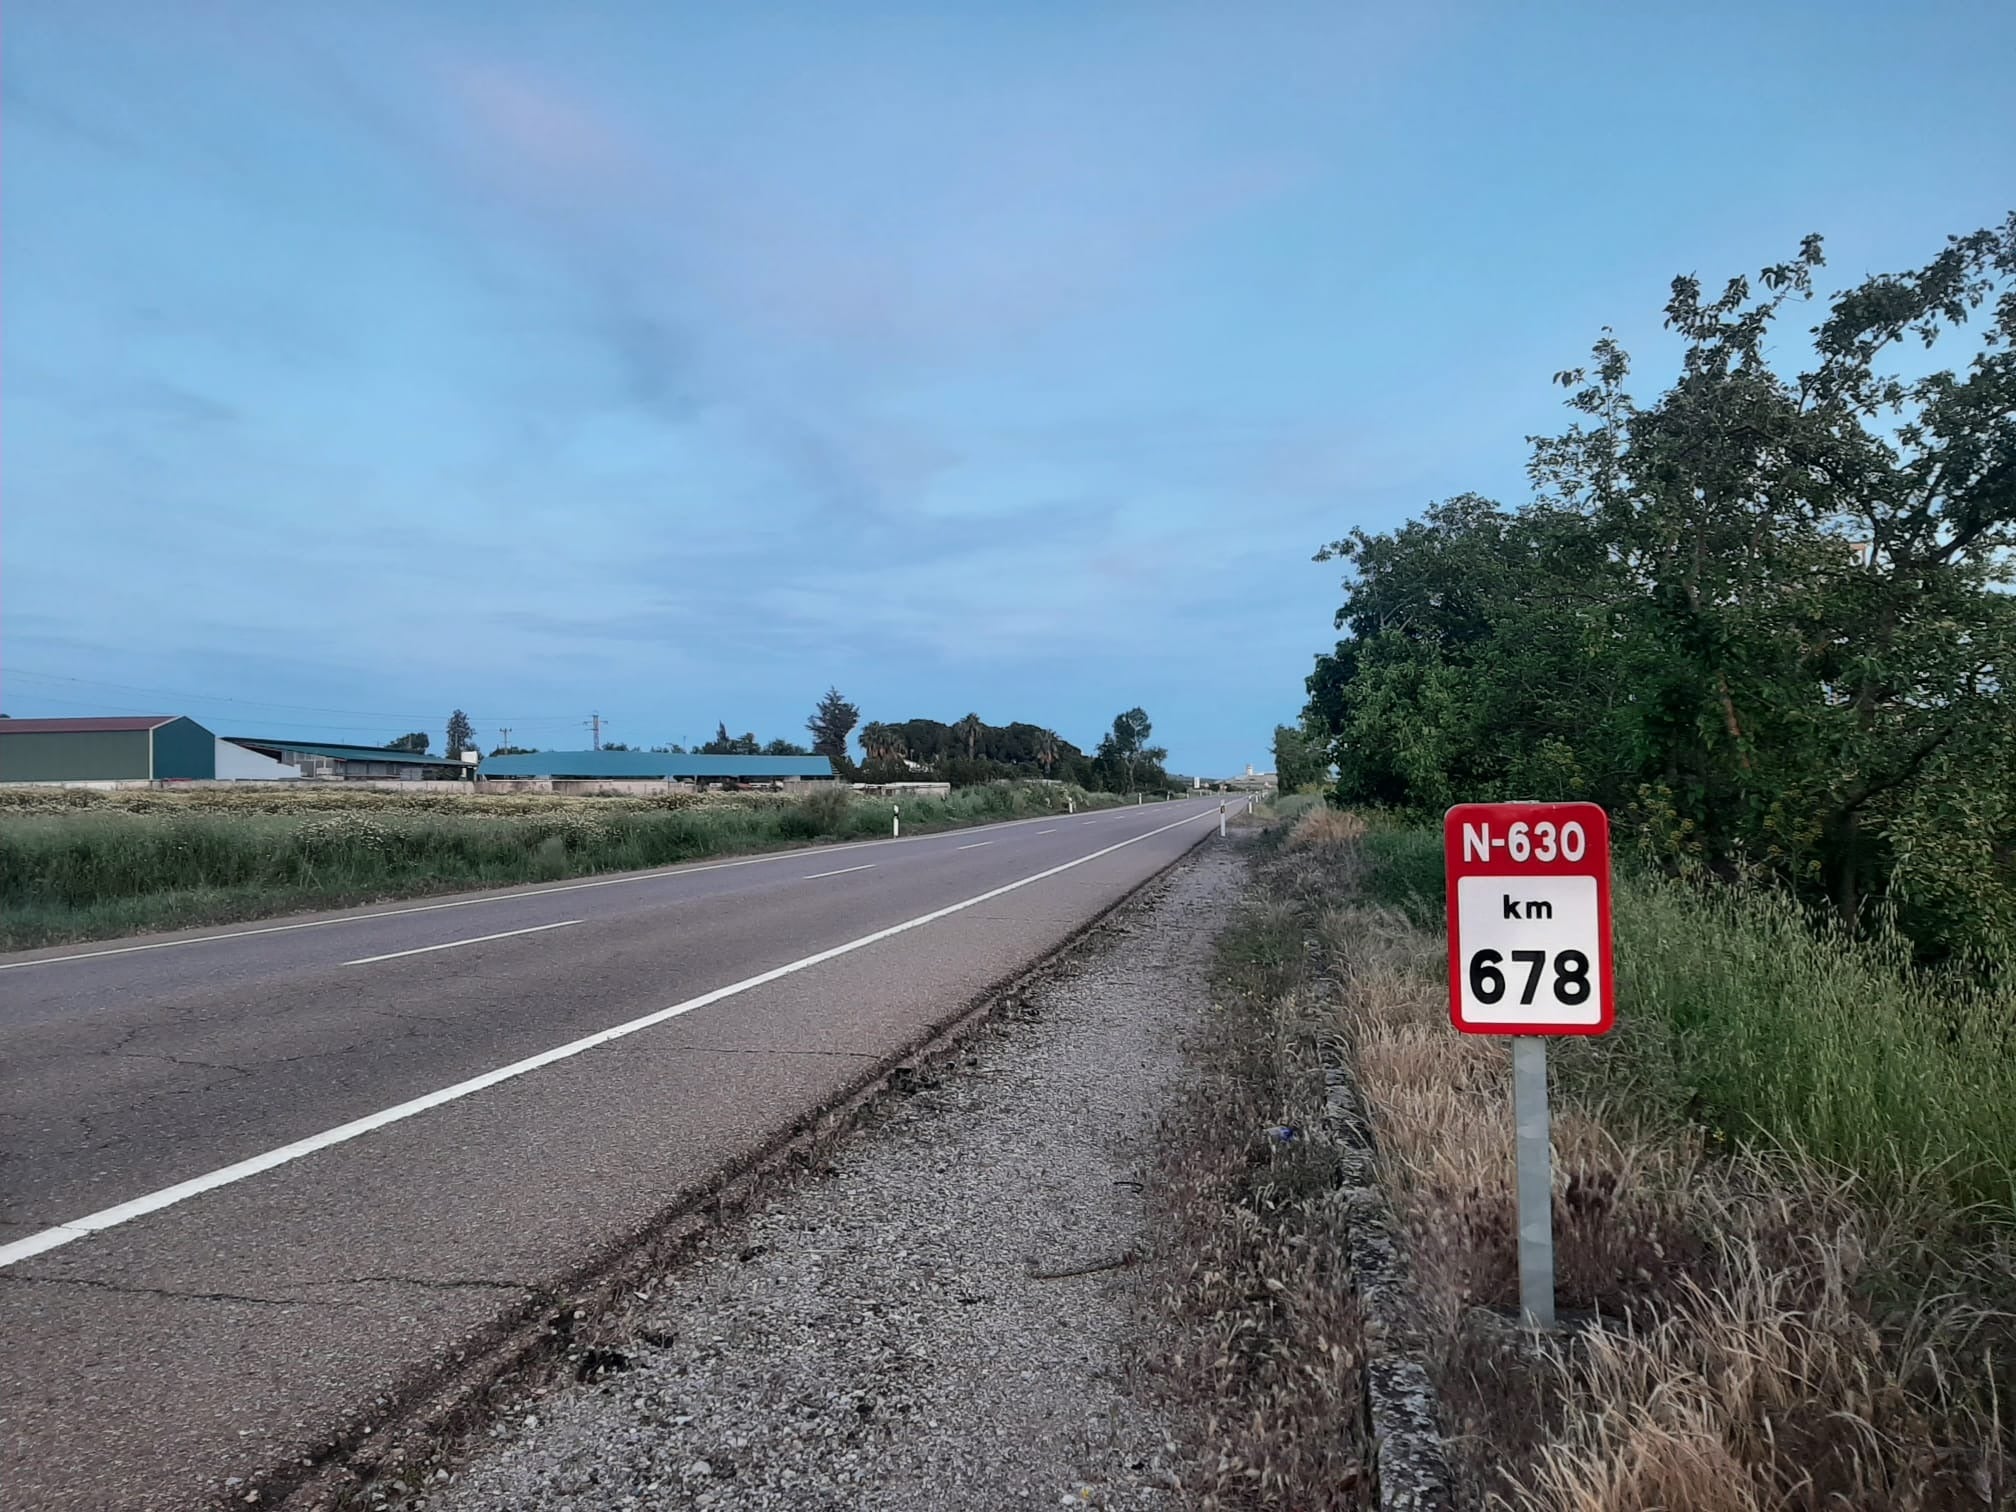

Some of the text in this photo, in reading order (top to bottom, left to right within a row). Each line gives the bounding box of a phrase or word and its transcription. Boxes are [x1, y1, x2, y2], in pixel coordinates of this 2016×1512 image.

[1463, 821, 1586, 862] N-630
[1503, 894, 1553, 919] km
[1469, 948, 1591, 1006] 678
